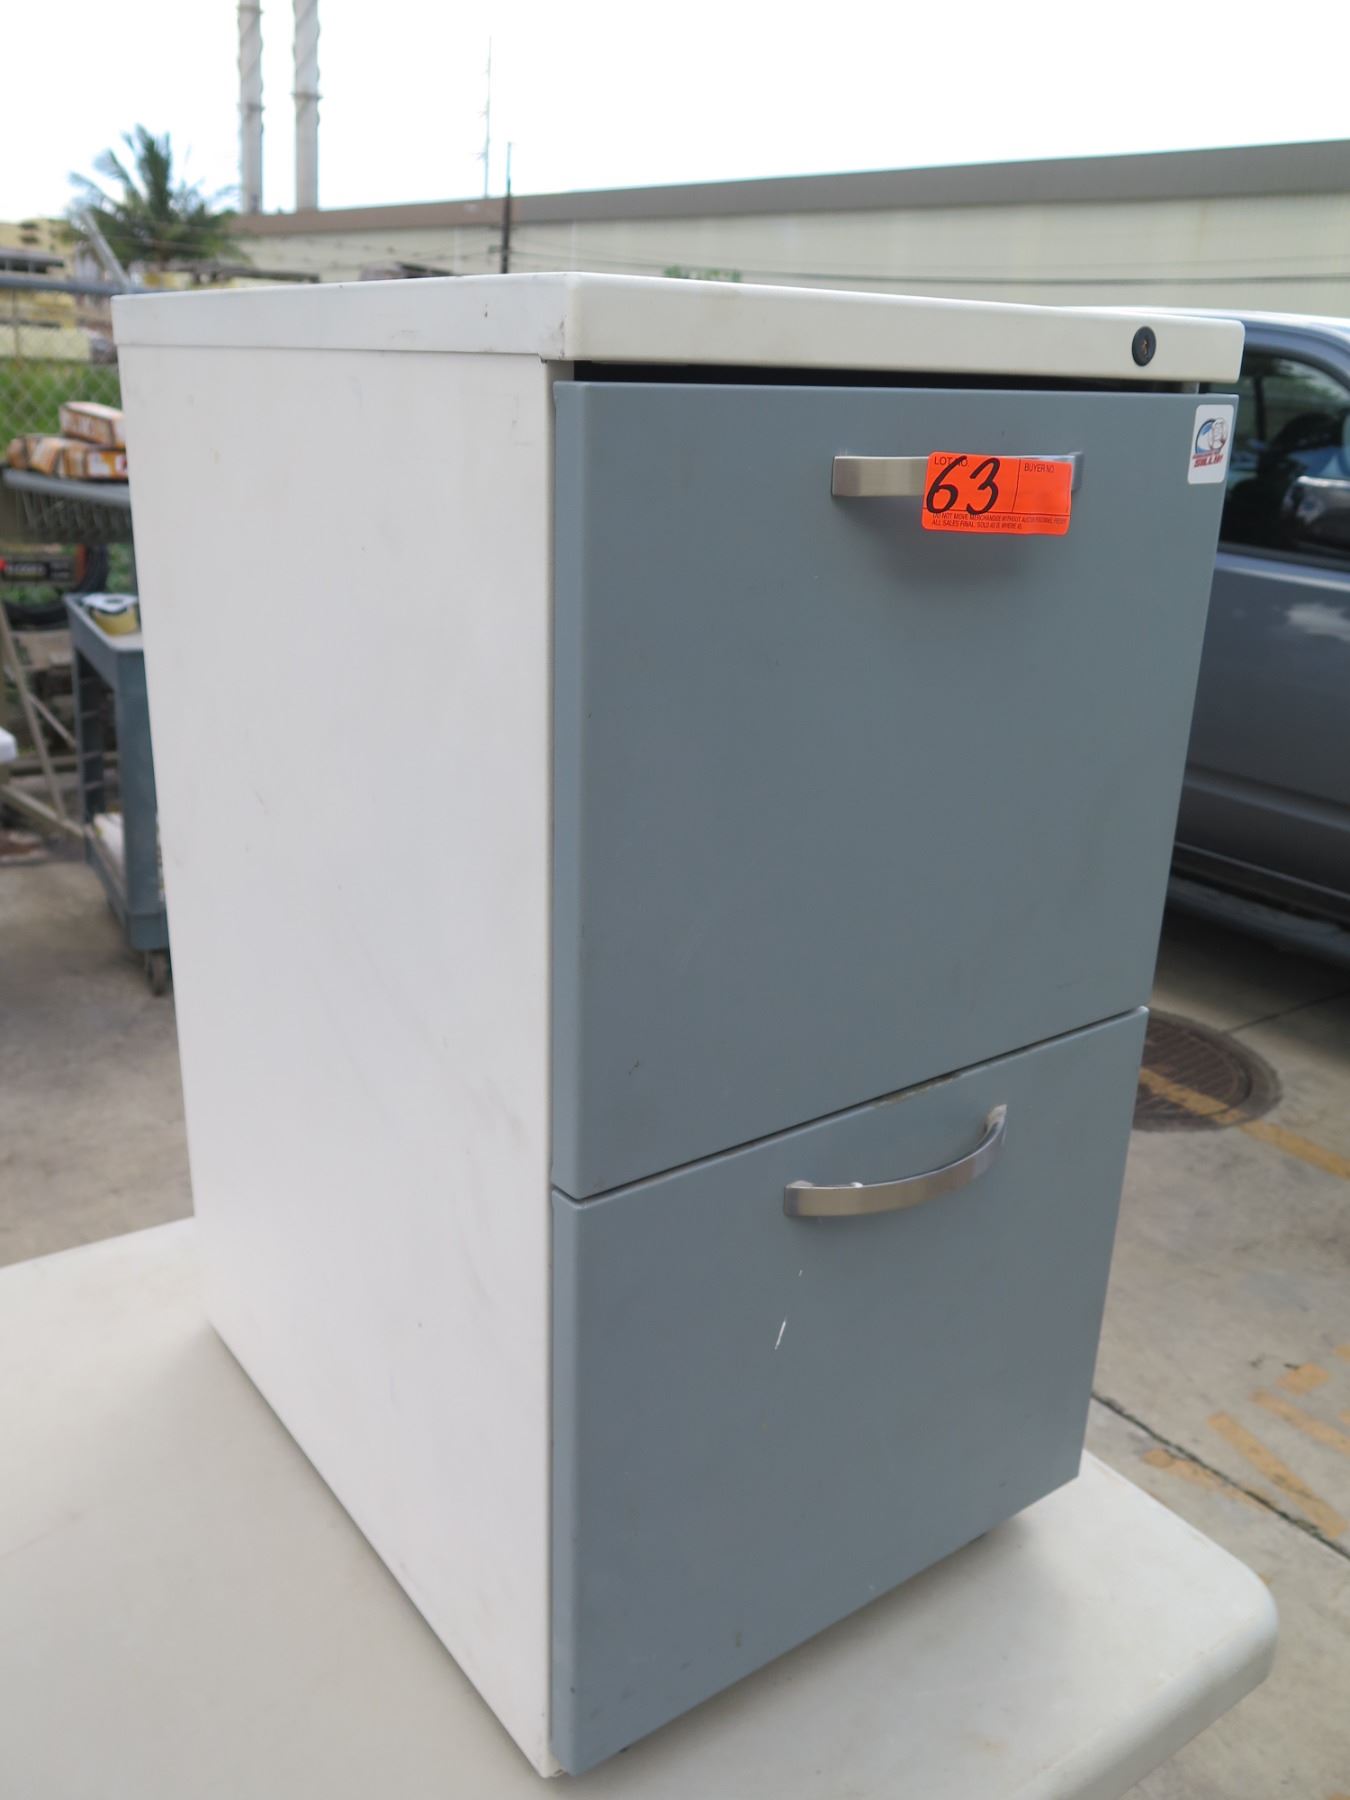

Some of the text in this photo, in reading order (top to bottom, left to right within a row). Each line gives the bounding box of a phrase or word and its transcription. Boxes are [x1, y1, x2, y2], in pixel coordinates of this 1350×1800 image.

[934, 456, 968, 467] LOT O
[1024, 463, 1045, 473] BUYER
[926, 455, 1001, 515] 63
[943, 519, 960, 527] SALES
